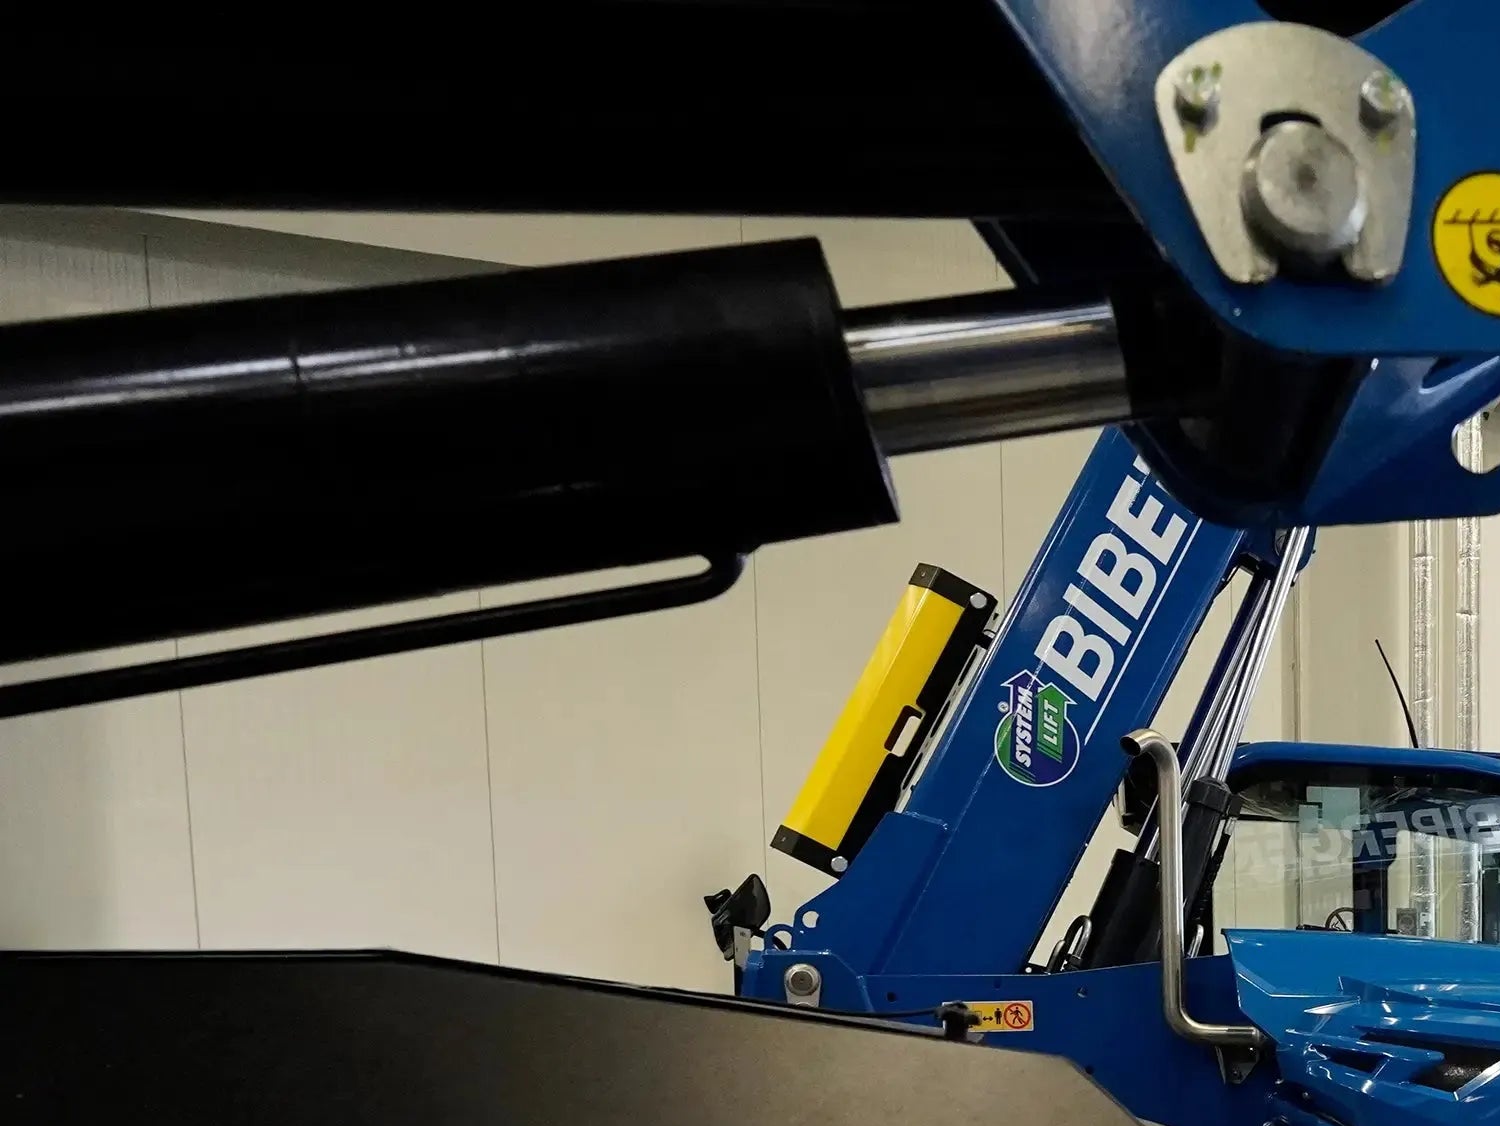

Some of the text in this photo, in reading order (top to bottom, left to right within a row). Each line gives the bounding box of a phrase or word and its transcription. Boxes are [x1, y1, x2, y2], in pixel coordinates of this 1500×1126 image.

[1034, 455, 1188, 702] BIBE
[1015, 685, 1033, 768] SYSTEM
[1043, 698, 1058, 746] LIFT
